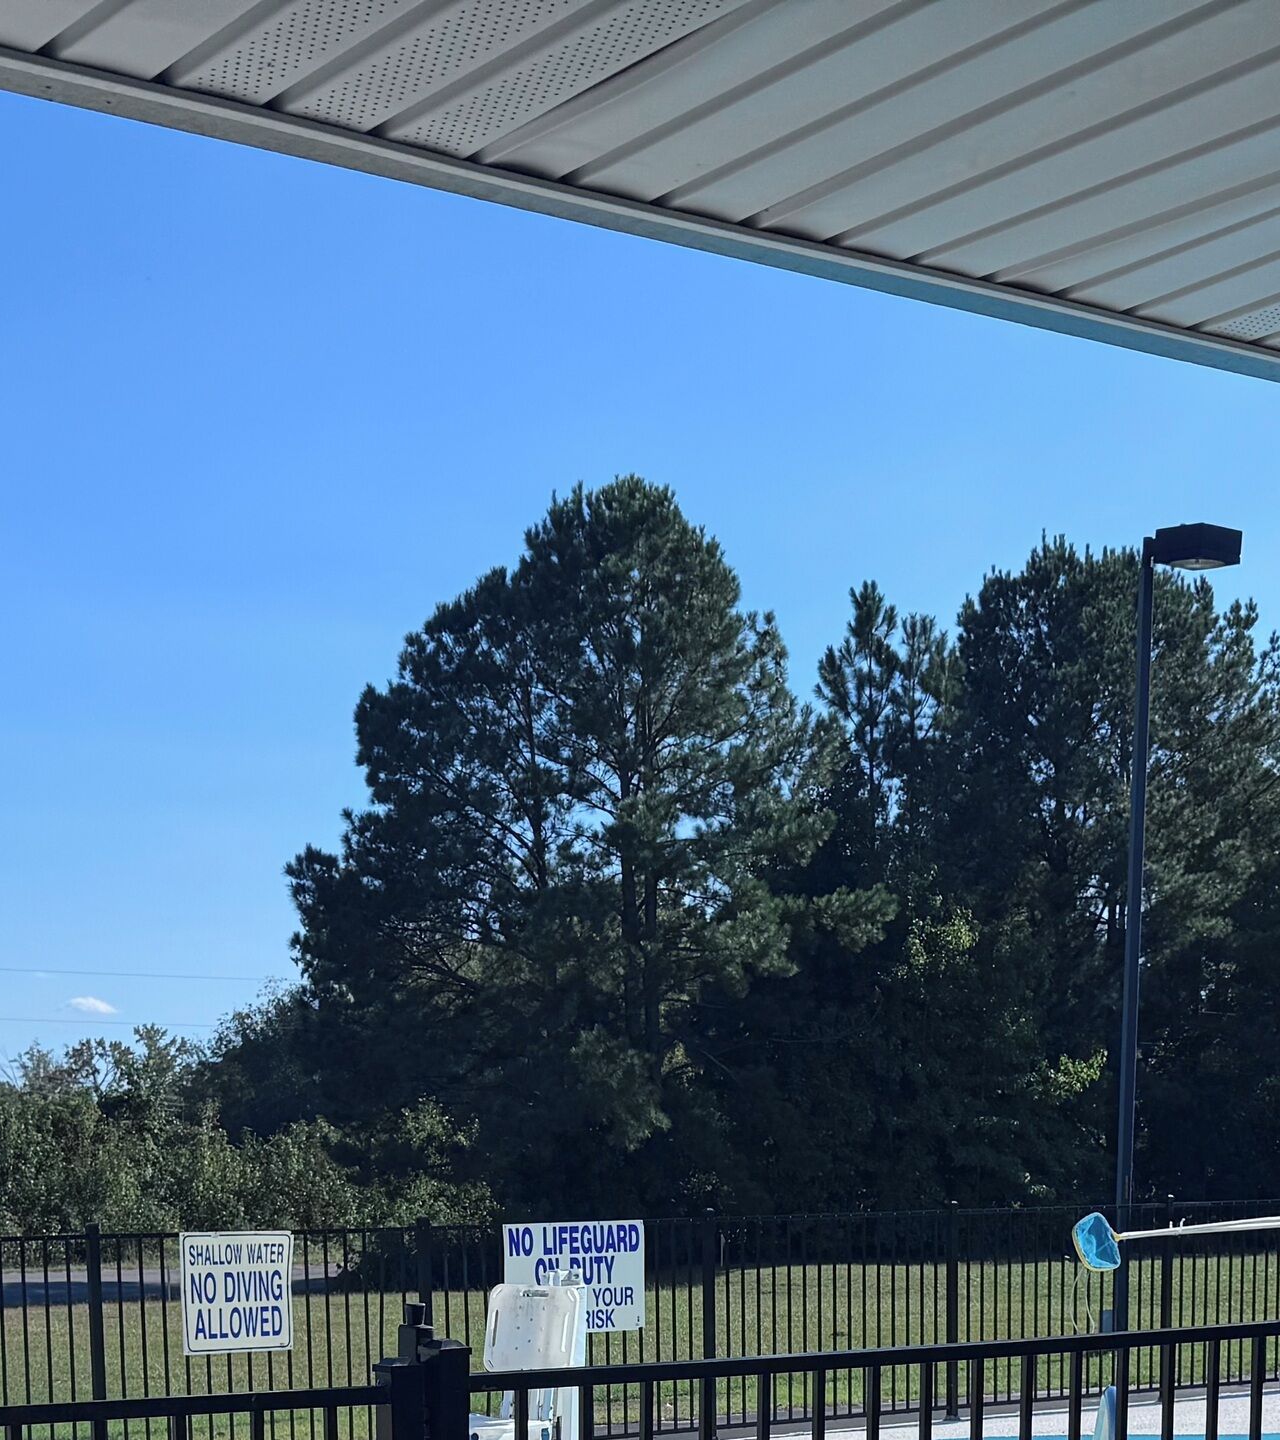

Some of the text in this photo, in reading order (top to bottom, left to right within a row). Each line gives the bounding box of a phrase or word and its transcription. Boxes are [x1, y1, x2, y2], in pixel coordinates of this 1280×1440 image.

[188, 1243, 285, 1266] SHALLOW WATER
[507, 1223, 640, 1257] NO LIFEGUARD
[190, 1269, 283, 1305] NO DIVING
[592, 1286, 634, 1308] YOUR
[194, 1305, 283, 1340] ALLOWED
